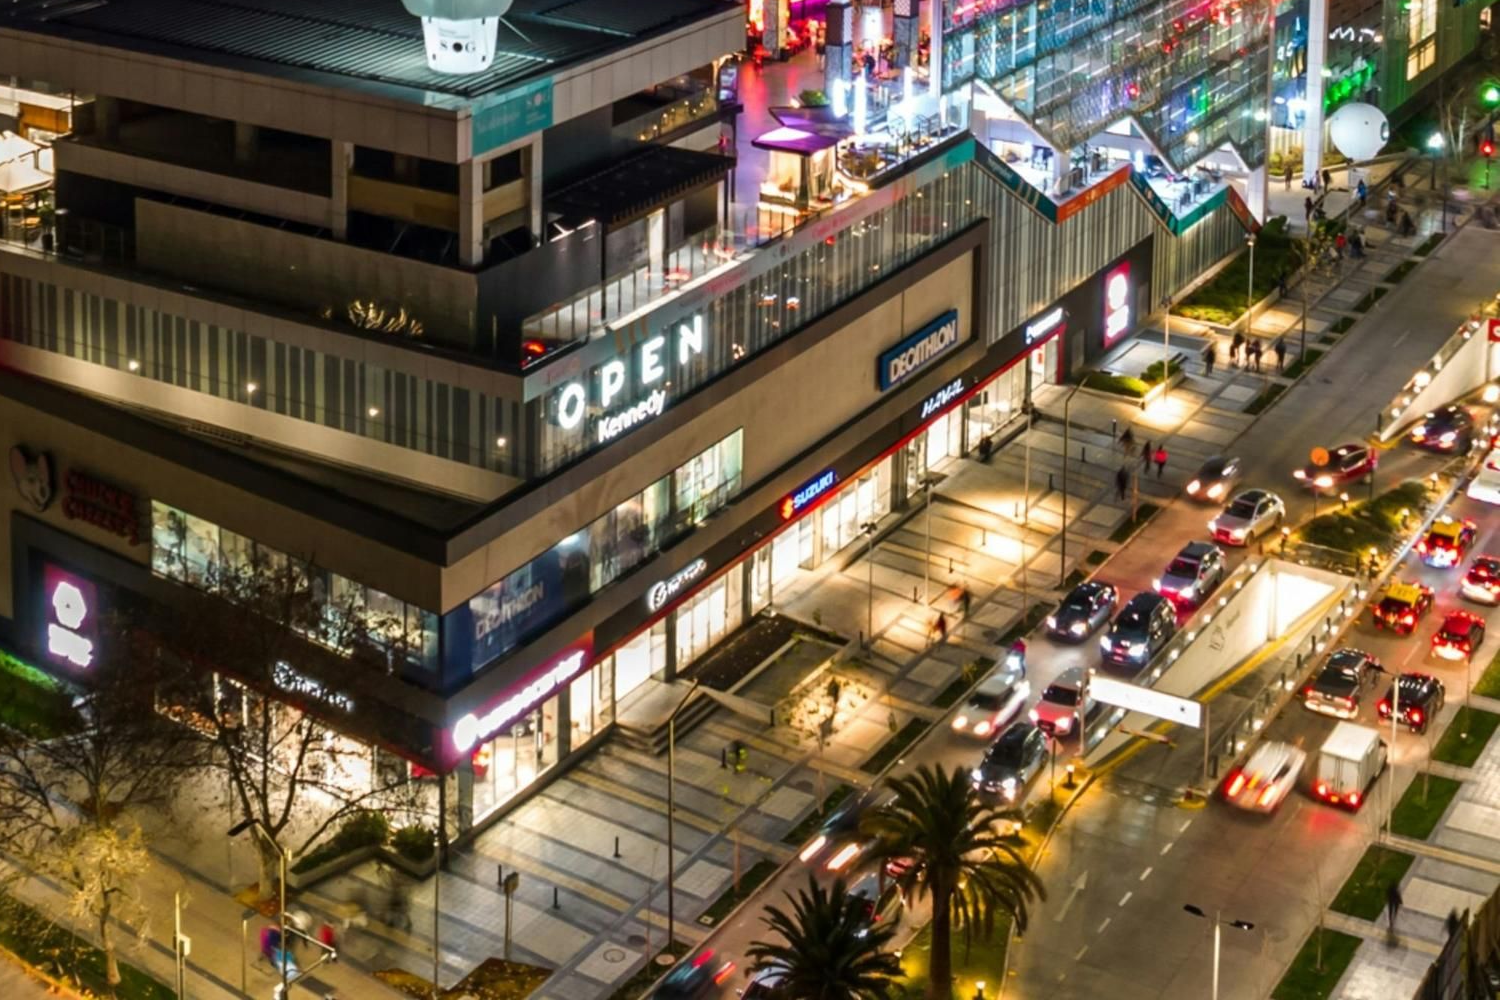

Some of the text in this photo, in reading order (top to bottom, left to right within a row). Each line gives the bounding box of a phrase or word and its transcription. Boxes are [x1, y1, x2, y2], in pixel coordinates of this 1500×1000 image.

[558, 314, 703, 430] OPEN
[889, 319, 957, 382] DECATHLON
[597, 389, 667, 443] Kennedy
[921, 378, 965, 419] HAVAL
[793, 471, 834, 509] SUZUKI
